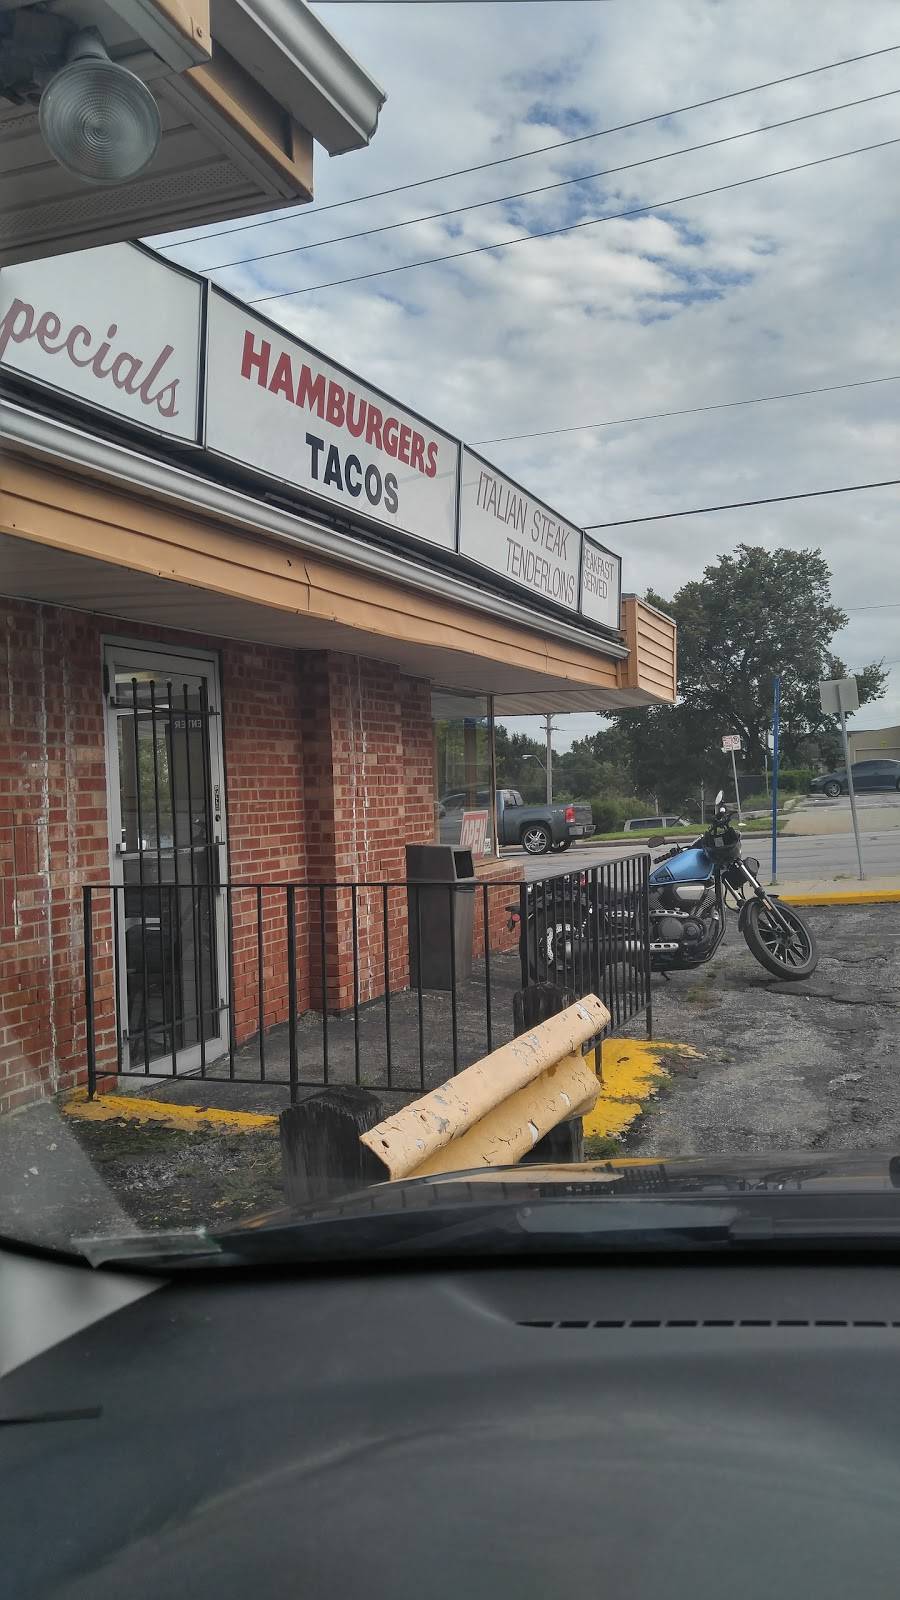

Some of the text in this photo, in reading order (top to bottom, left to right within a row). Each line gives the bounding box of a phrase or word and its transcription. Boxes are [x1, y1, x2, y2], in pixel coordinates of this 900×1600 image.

[240, 330, 439, 479] HAMBURGERS
[305, 431, 400, 514] TACOS
[476, 471, 570, 561] ITALIAN STEAK
[506, 537, 575, 605] TENDERLOINS
[584, 569, 608, 600] SERVED
